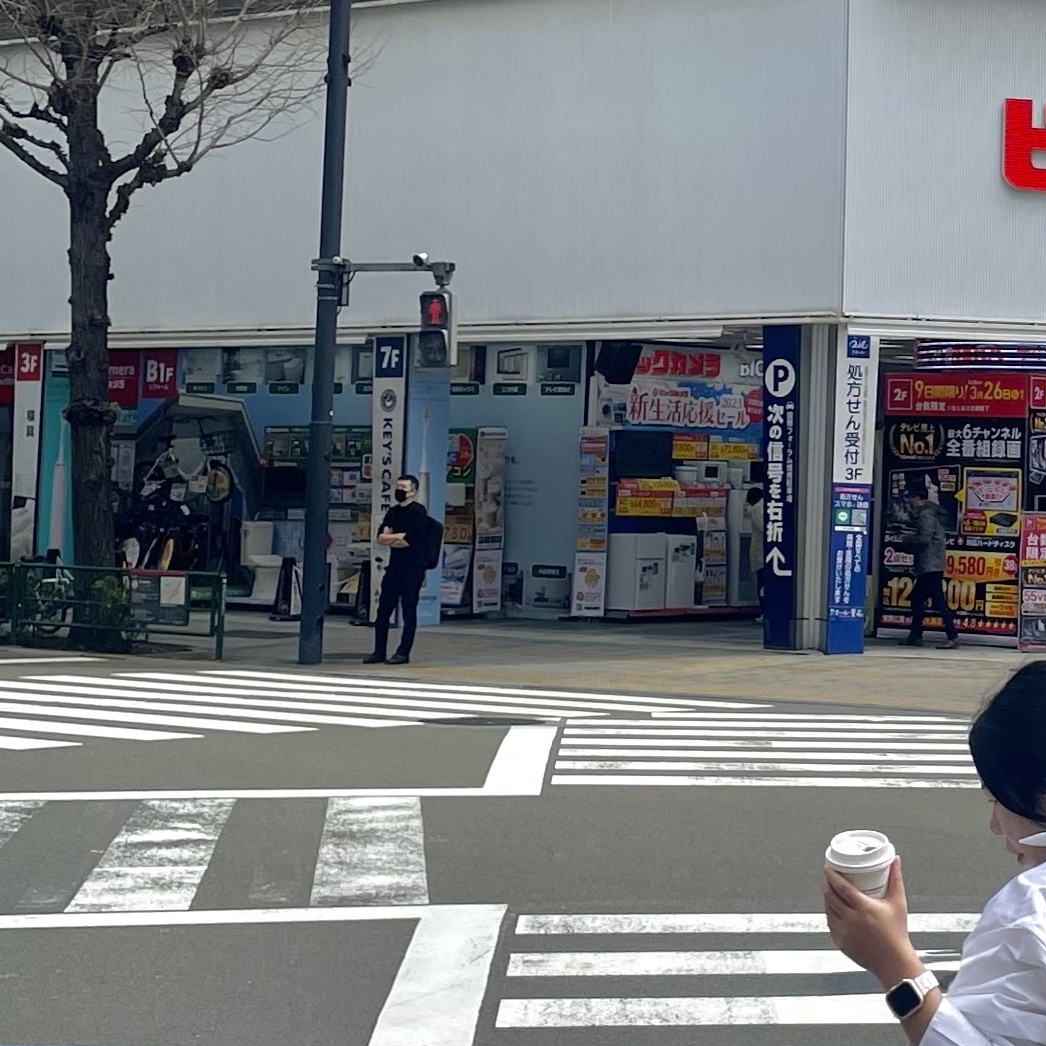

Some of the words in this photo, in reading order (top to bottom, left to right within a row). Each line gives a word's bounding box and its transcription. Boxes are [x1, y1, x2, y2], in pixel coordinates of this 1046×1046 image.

[20, 352, 38, 373] 3F
[380, 346, 400, 369] 7F
[146, 359, 174, 383] B1F
[894, 388, 907, 401] 2F
[1034, 386, 1044, 400] 2F
[629, 391, 747, 426] 新生活応援セール
[845, 363, 863, 465] 処方せん受付
[381, 417, 394, 466] KEY'S
[947, 423, 1021, 440] 最大6チャンネル
[900, 433, 935, 455] No.1
[946, 439, 1021, 458] 全番組録画
[766, 403, 784, 542] 次の信号を右折
[845, 467, 863, 481] 3F
[379, 468, 394, 512] CAFE
